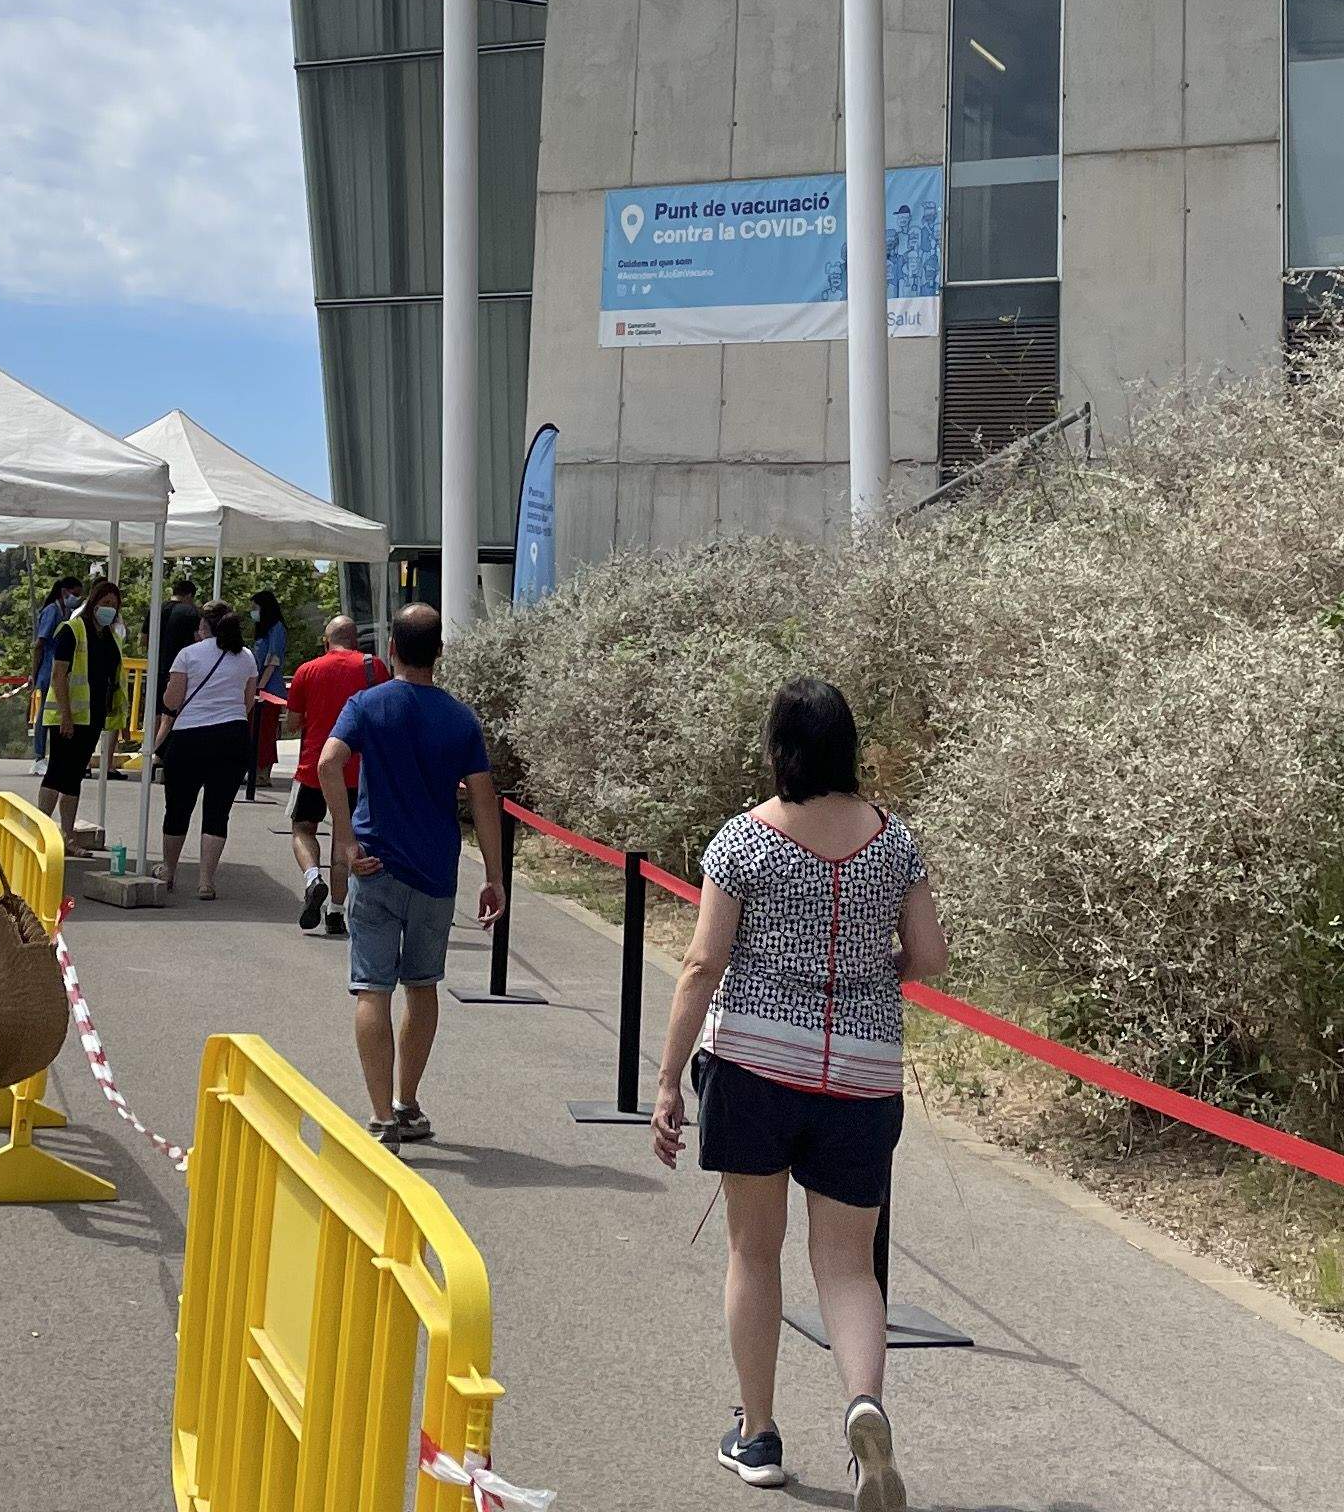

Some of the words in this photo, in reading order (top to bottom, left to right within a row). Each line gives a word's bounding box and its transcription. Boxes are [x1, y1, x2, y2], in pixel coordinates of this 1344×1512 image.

[655, 202, 698, 220] Punt
[703, 200, 726, 217] de
[731, 191, 830, 216] vacunació
[653, 225, 714, 245] contra
[718, 222, 736, 241] la
[739, 215, 837, 239] COVID-19
[887, 311, 921, 326] Salut
